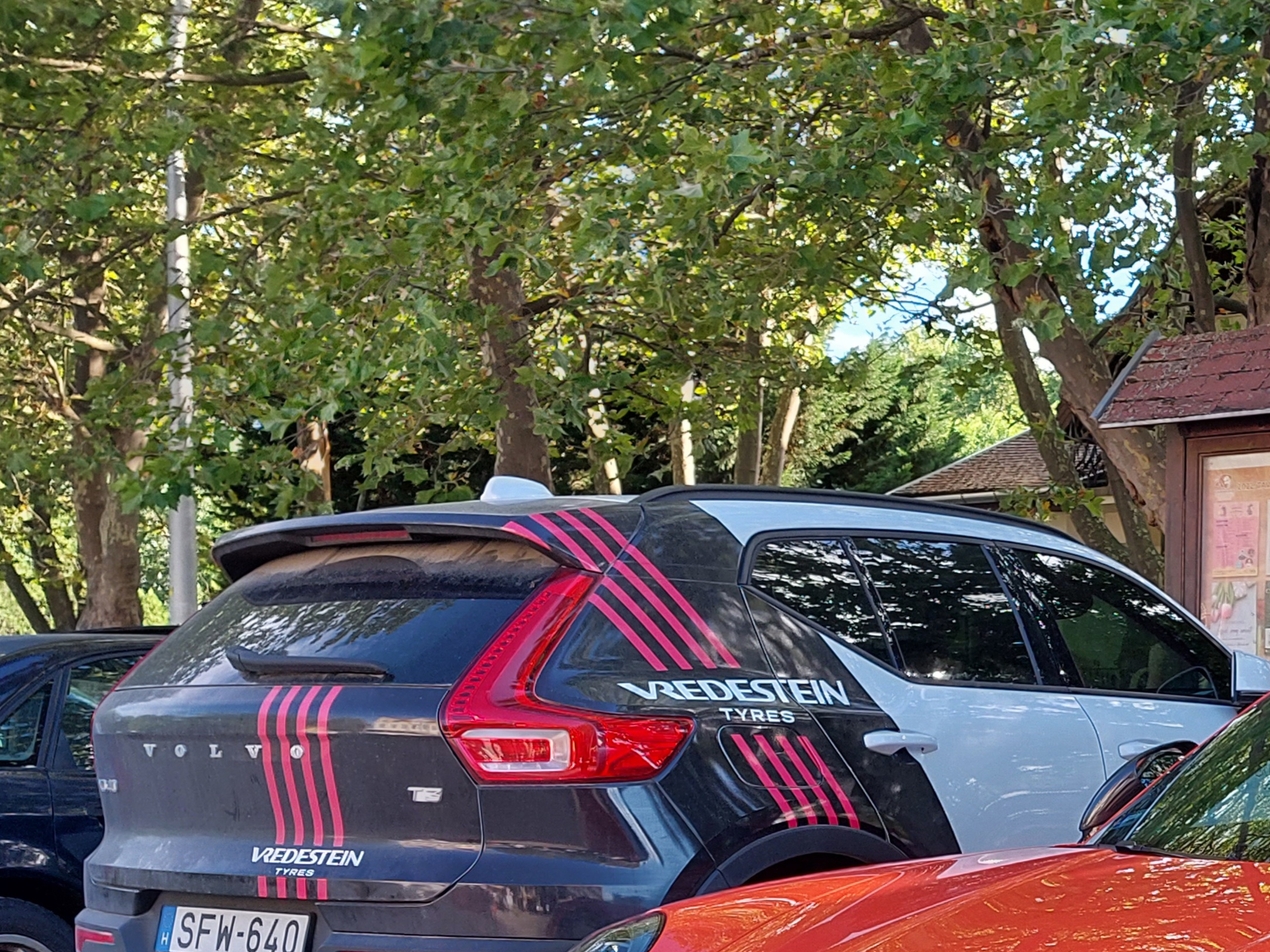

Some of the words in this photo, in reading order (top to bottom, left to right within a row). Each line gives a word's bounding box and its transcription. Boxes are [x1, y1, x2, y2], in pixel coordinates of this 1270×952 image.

[616, 679, 851, 706] VREDESTEIN
[718, 707, 796, 723] TYRES
[143, 743, 304, 759] VOLVO
[251, 846, 365, 867] VREDESTEIN
[275, 867, 315, 877] TYRES
[160, 931, 169, 946] H
